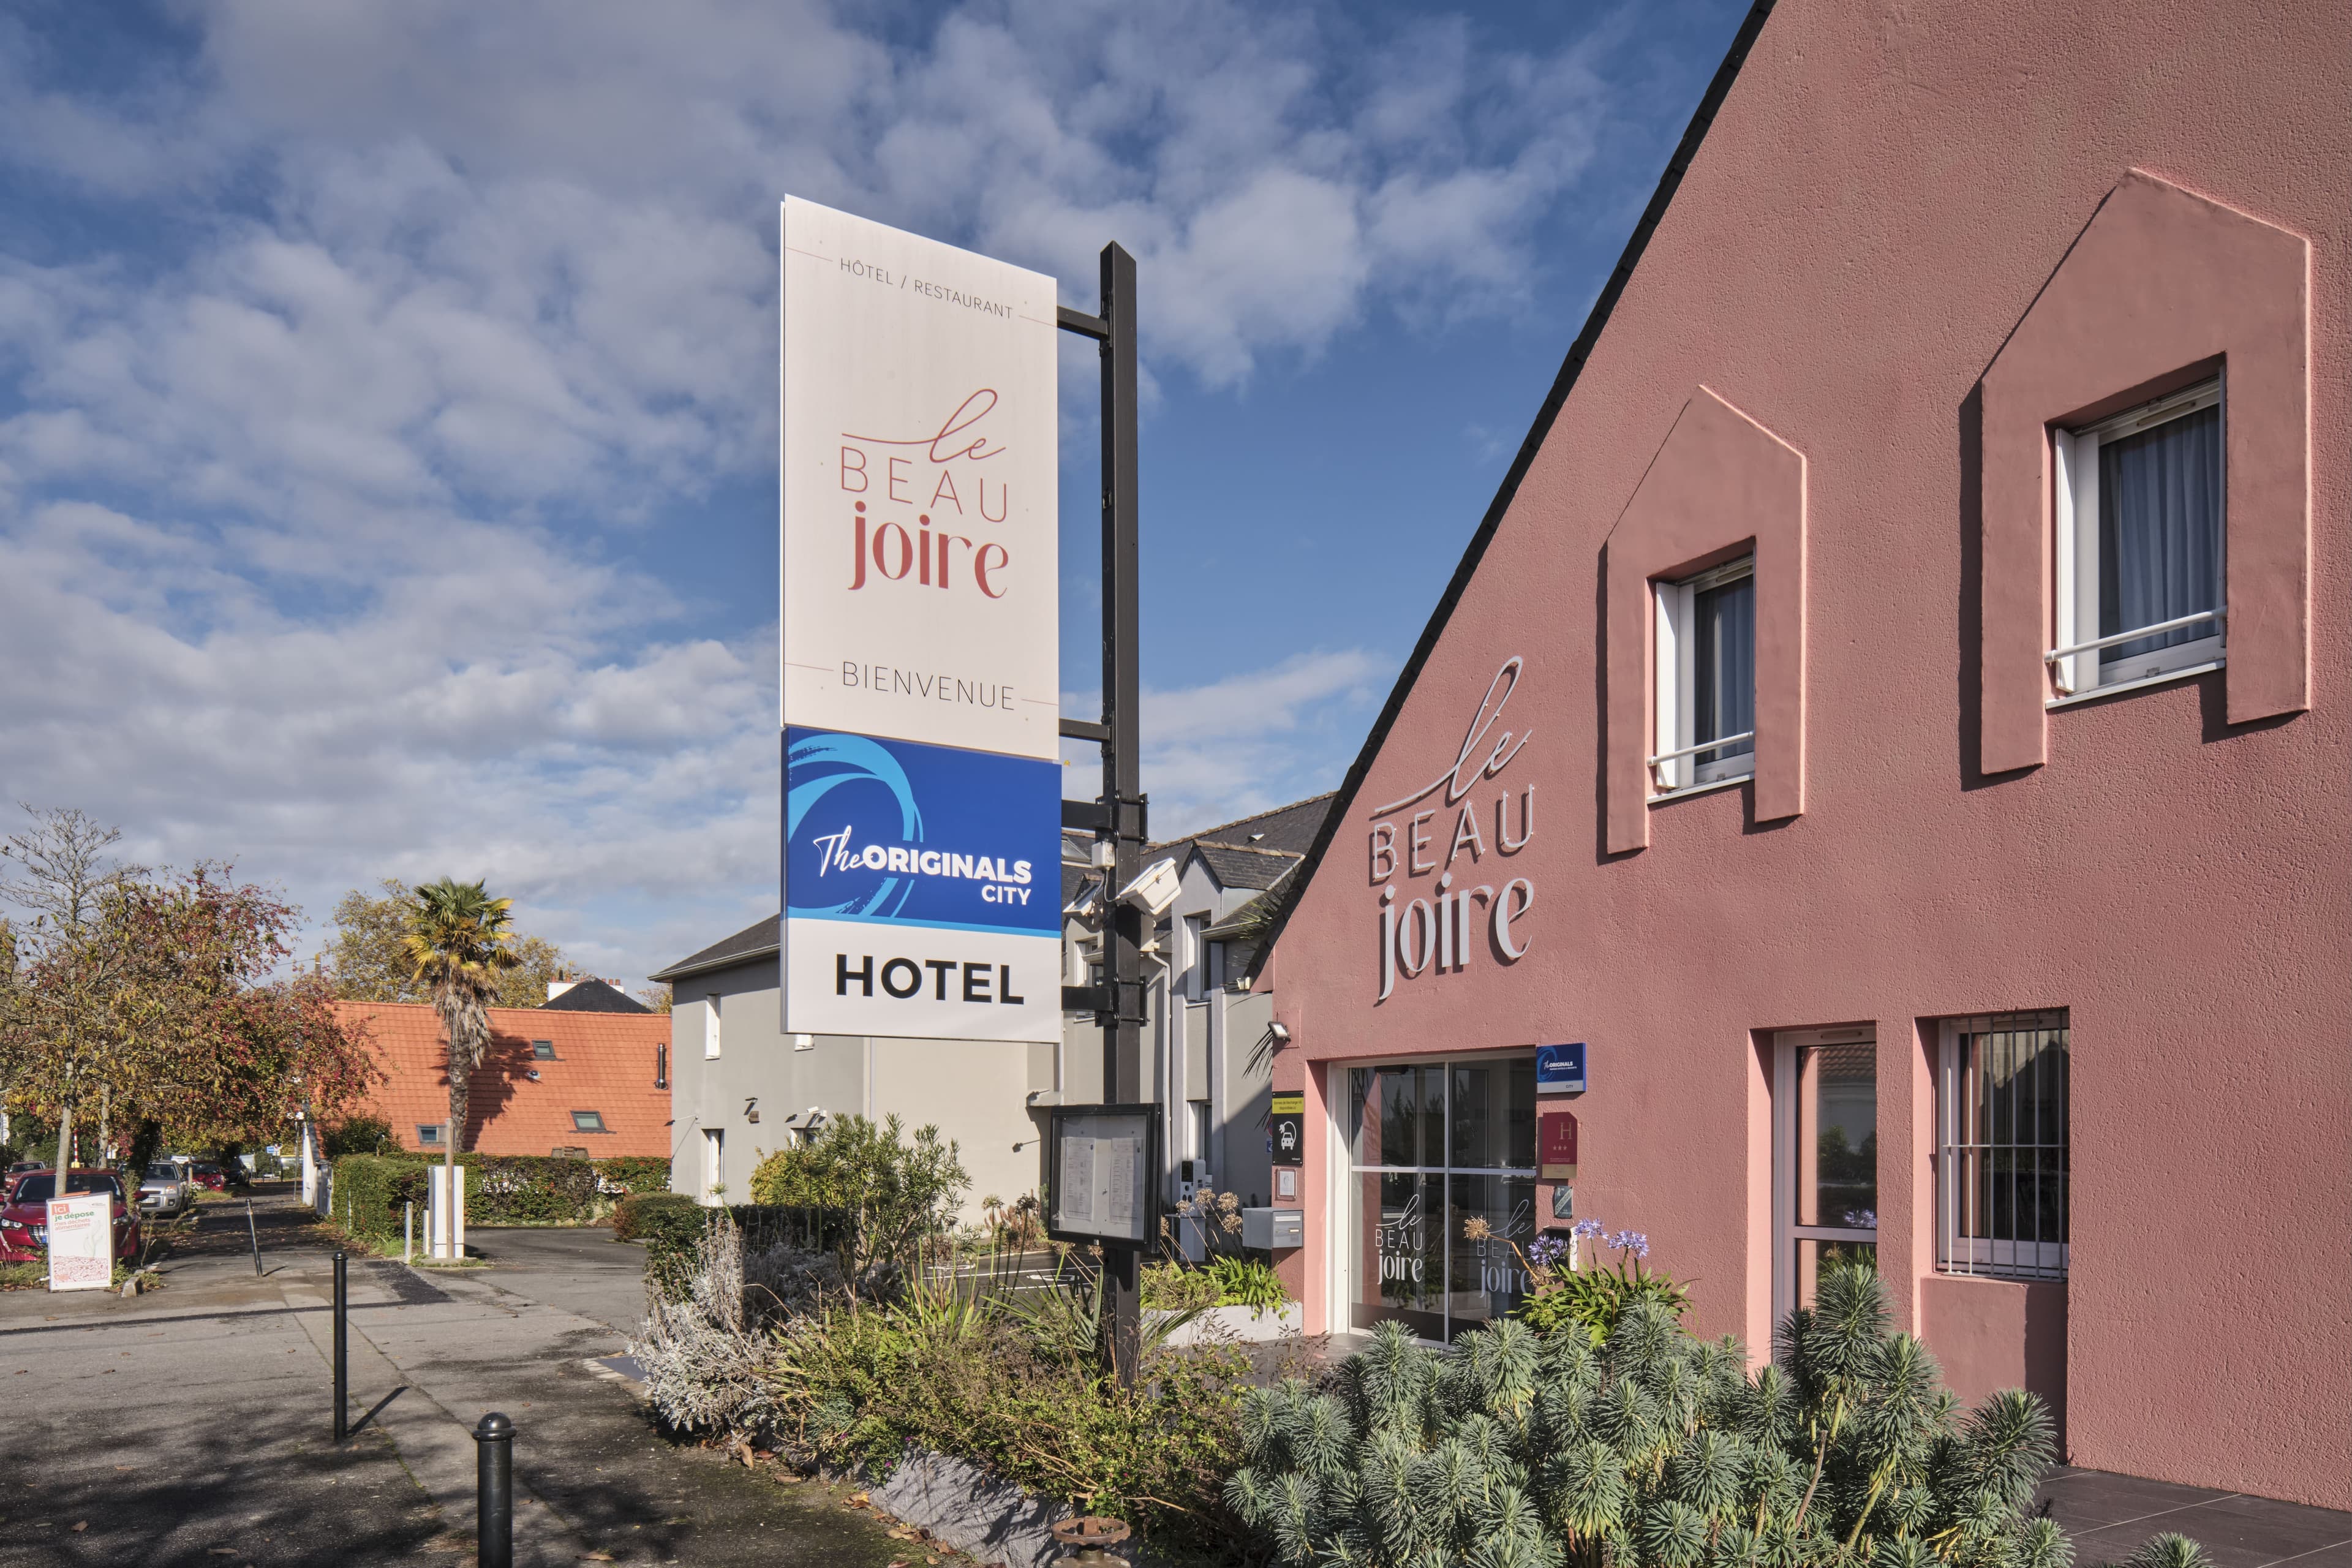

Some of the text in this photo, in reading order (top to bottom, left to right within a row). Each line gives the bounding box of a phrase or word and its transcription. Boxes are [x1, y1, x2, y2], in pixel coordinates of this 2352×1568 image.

[840, 257, 1013, 320] HÔTEL / RESTAURANT
[842, 388, 1006, 463] le
[841, 446, 1008, 523] BEAU
[847, 500, 1009, 599] joire
[843, 661, 1015, 711] BIENVENUE
[1374, 655, 1532, 799] le
[1374, 783, 1534, 880] BEAU
[862, 844, 1032, 884] ORIGINALS
[981, 884, 1031, 906] CITY
[1379, 872, 1534, 1000] joire
[835, 953, 1025, 1005] HOTEL
[1559, 1122, 1573, 1139] H
[54, 1205, 67, 1213] Ici
[64, 1211, 94, 1219] dépose
[1376, 1194, 1422, 1230] le
[1489, 1199, 1532, 1238] le
[1376, 1229, 1422, 1250] BEAU
[1477, 1237, 1532, 1261] BEAU
[1377, 1249, 1423, 1285] joire
[1479, 1259, 1532, 1298] joire
